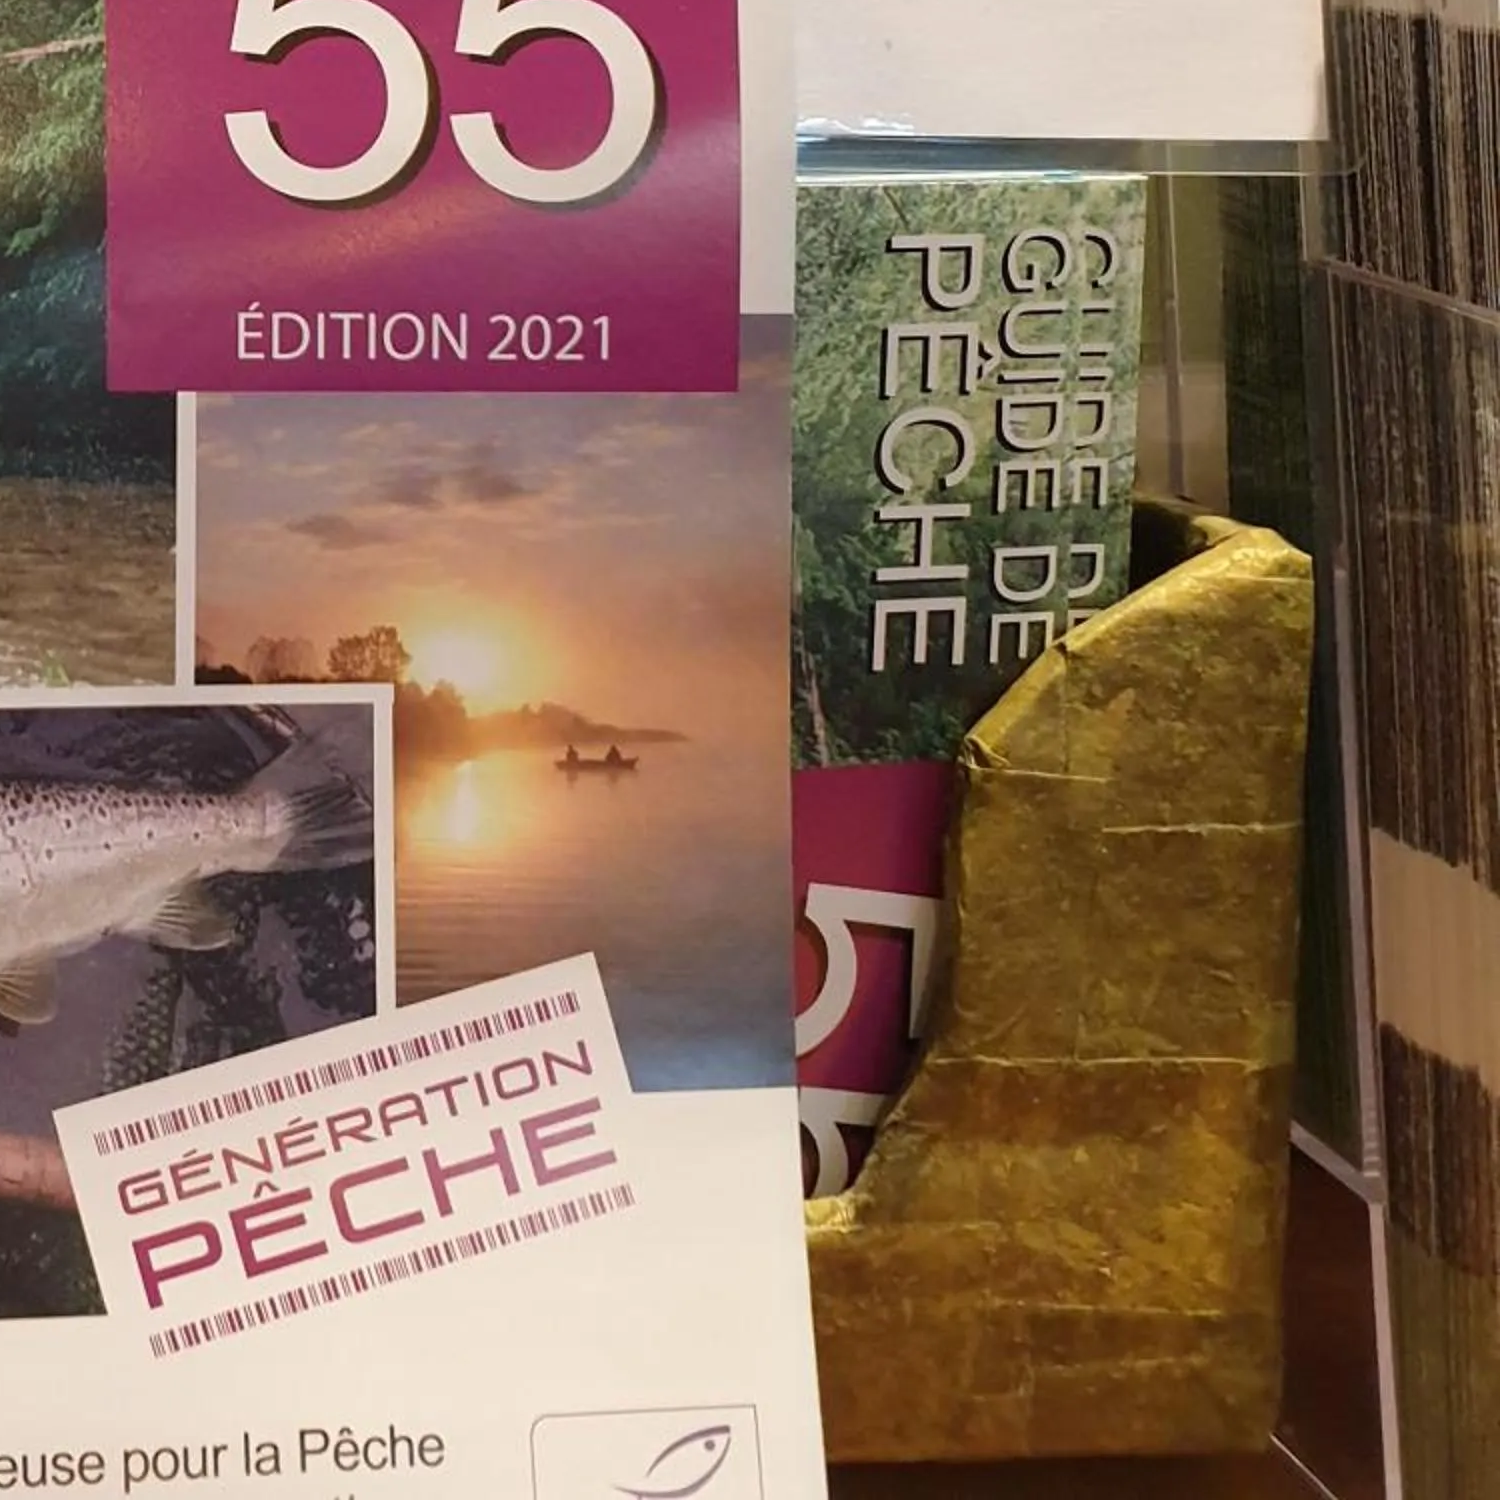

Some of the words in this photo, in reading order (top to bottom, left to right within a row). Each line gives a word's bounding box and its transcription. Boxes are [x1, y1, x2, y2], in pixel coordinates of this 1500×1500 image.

[237, 302, 468, 361] ÉDITION
[487, 314, 610, 361] 2021
[994, 228, 1072, 513] GUIDE
[871, 233, 999, 672] PÊCHE
[989, 543, 1058, 664] DE
[117, 1040, 594, 1216] GÉNÉRATION
[131, 1097, 618, 1310] PÊCHE
[122, 1443, 228, 1494] pour
[242, 1431, 282, 1476] la
[299, 1424, 446, 1474] Pêche
